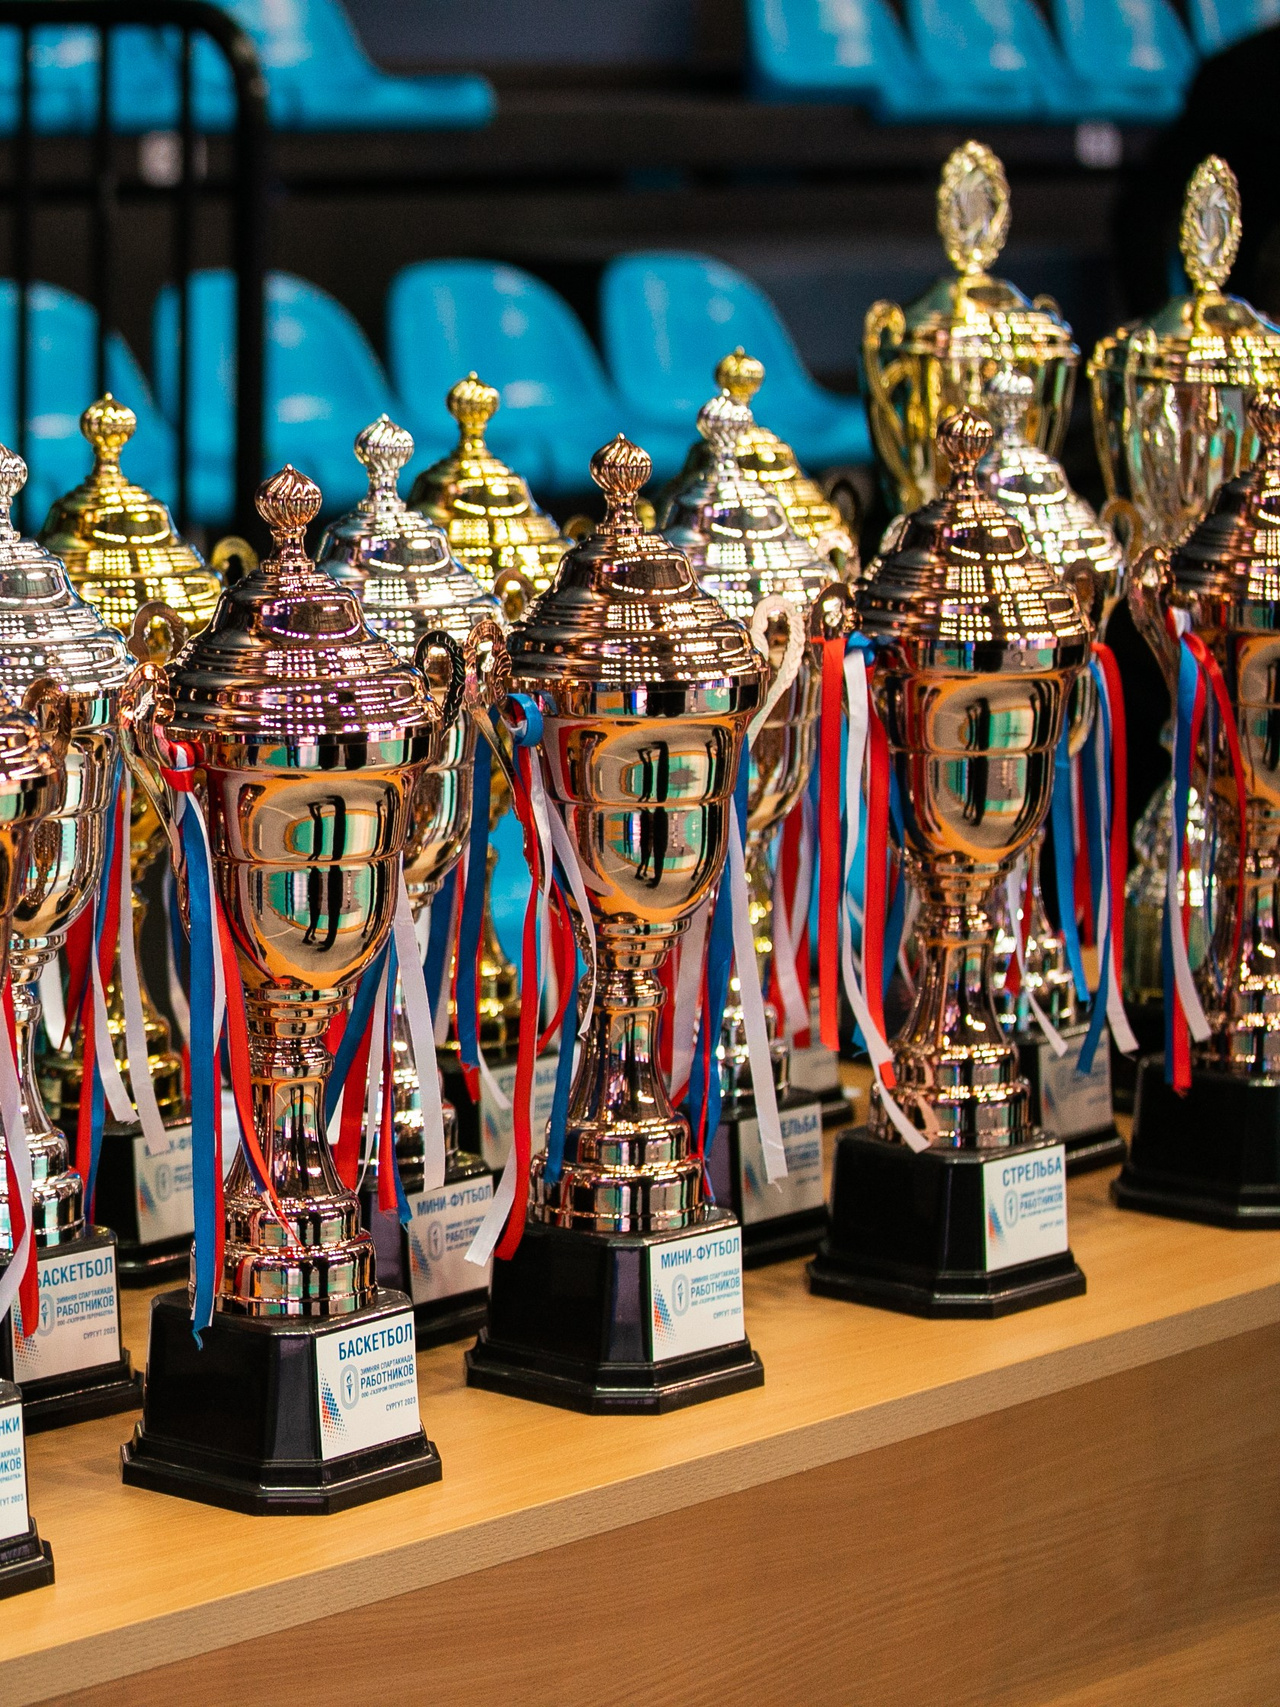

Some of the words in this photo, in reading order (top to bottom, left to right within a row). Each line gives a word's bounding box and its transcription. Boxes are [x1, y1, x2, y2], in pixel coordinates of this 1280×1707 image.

[1002, 1156, 1062, 1187] СТРЕЛЬБА
[416, 1184, 491, 1216] МИНИ-ФУТБОЛ
[661, 1237, 740, 1270] МИНИ-ФУТБОЛ
[78, 1286, 114, 1300] СПАРТАКИАДА
[690, 1276, 741, 1299] РАБОТНИКОВ
[56, 1295, 115, 1318] РАБОТНИКОВ
[83, 1329, 103, 1340] СУРГУТ
[338, 1323, 413, 1361] БАСКЕТБОЛ
[380, 1354, 414, 1370] СПАРТАКИАДА
[360, 1363, 415, 1390] РАБОТНИКОВ
[385, 1399, 404, 1412] СУРГУТ
[404, 1396, 417, 1406] 2023
[10, 1493, 24, 1504] 2023
